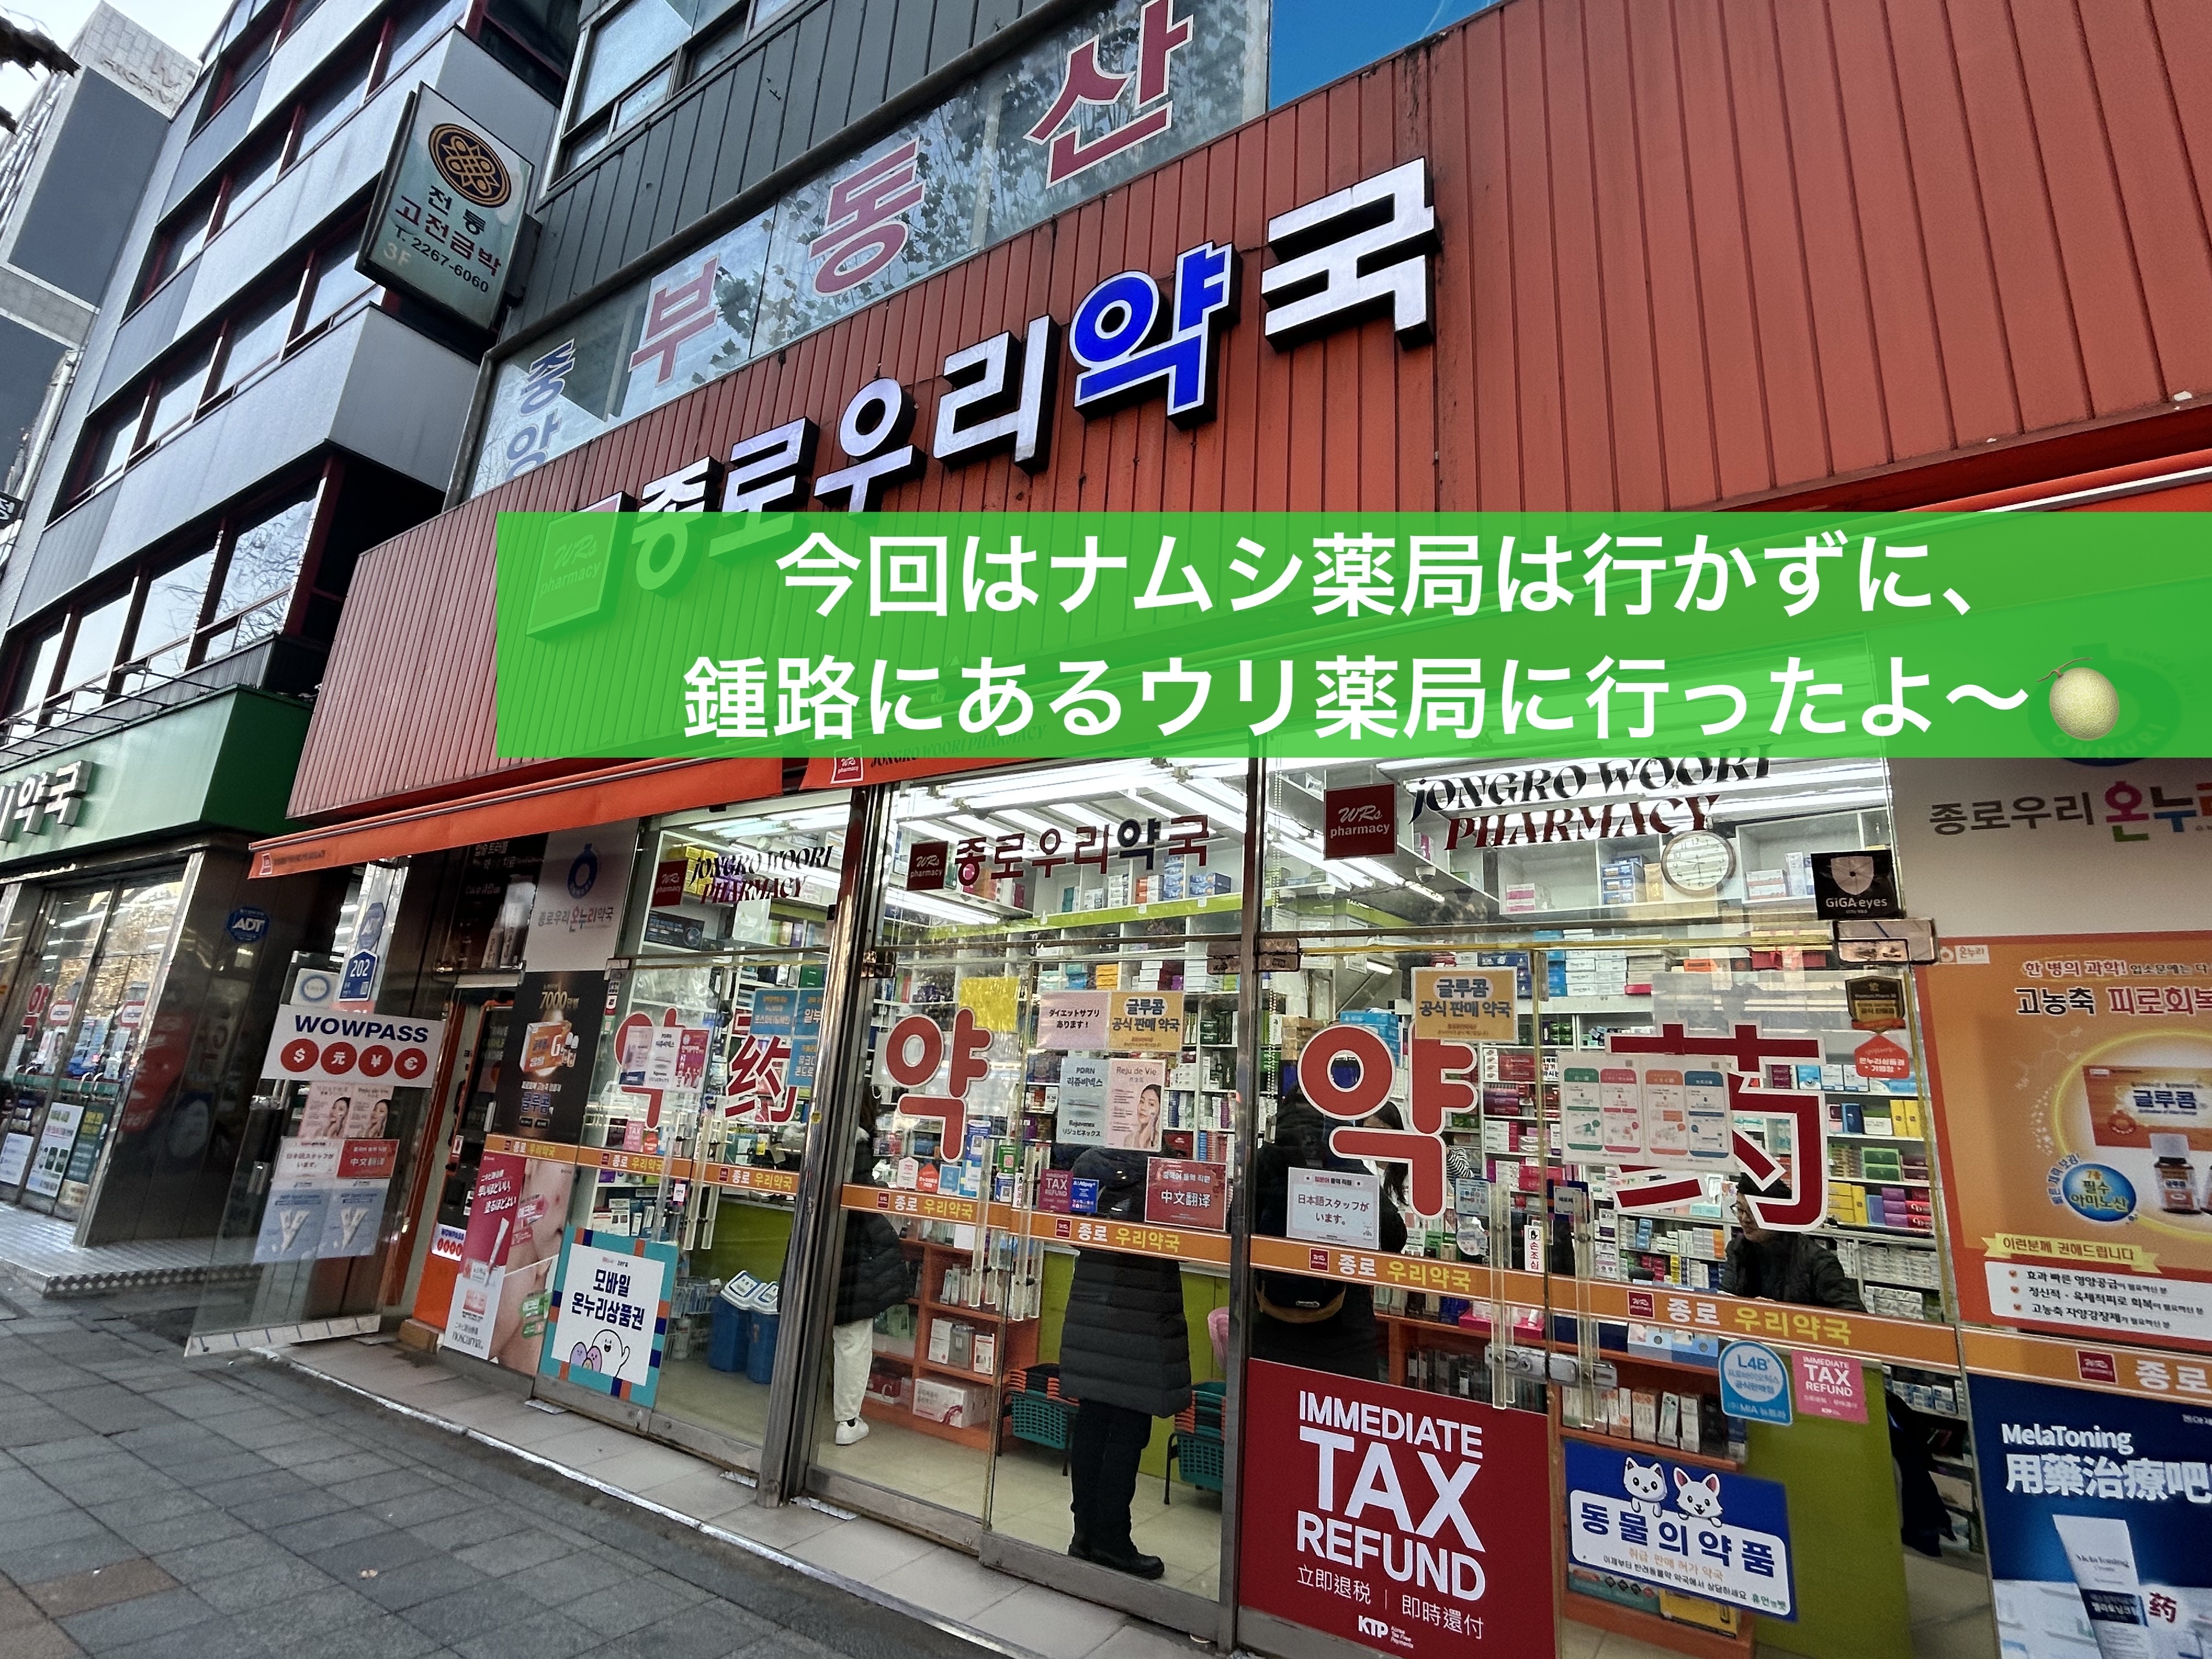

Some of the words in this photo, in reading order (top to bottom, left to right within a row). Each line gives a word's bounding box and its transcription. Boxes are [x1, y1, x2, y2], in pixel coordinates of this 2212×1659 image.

[384, 242, 412, 266] 3F
[411, 236, 489, 293] 2267-6060
[632, 156, 1436, 592] 종로우리약국
[539, 561, 602, 599] pharmacy
[1599, 743, 1773, 793] WOORI
[0, 760, 82, 840] 약국
[1338, 805, 1383, 823] WRs
[1330, 821, 1391, 839] pharmacy
[1444, 795, 1720, 850] PHARMACY
[916, 854, 940, 870] WRs
[955, 815, 1211, 887] 종로우리약국
[910, 865, 943, 879] pharmacy
[700, 876, 808, 905] PHARMACY
[1859, 898, 1888, 910] eyes
[232, 918, 265, 933] ADT
[350, 958, 370, 977] 202
[2025, 962, 2041, 976] 한
[2047, 961, 2080, 976] 병의
[2085, 961, 2126, 975] 과학!
[1436, 979, 1489, 998] 글루콤
[2016, 987, 2095, 1015] 고농축
[1048, 1008, 1100, 1018] ダイエットサプリ
[1125, 998, 1165, 1015] 글루콤
[1419, 1000, 1447, 1017] 공식
[1449, 1001, 1480, 1018] 판매
[1482, 1001, 1512, 1018] 약국
[295, 1014, 430, 1043] WOWPASS
[1111, 1017, 1132, 1032] 공식
[1134, 1017, 1156, 1032] 판매
[1158, 1018, 1181, 1032] 약국
[885, 1007, 994, 1163] 약
[2133, 1090, 2197, 1109] 글루콤
[1298, 1020, 1477, 1219] 약
[612, 1154, 628, 1167] 종로
[731, 1170, 751, 1185] 종로
[754, 1171, 793, 1191] 우리약국
[1046, 1177, 1068, 1190] TAX
[895, 1195, 918, 1212] 종로
[924, 1199, 974, 1220] 우리약국
[1161, 1189, 1211, 1208] 中文翻译
[1297, 1193, 1370, 1212] 日本語スタッフが
[1314, 1211, 1346, 1226] います。
[1077, 1222, 1108, 1243] 종로
[1115, 1228, 1181, 1254] 우리약국
[1530, 1241, 1539, 1270] 손조심
[592, 1268, 631, 1298] 모바일
[1338, 1254, 1377, 1277] 종로
[1387, 1260, 1471, 1291] 우리약국
[572, 1291, 645, 1331] 온누리상품권
[1667, 1297, 1720, 1326] 종로
[1735, 1307, 1852, 1346] 우리약국
[1803, 1355, 1850, 1370] IMMEDIATE
[1803, 1363, 1852, 1387] TAX
[1805, 1381, 1853, 1397] REFUND
[2136, 1359, 2212, 1395] 종로
[1299, 1390, 1483, 1460] IMMEDIATE
[2001, 1423, 2135, 1456] MelaToning
[1299, 1425, 1486, 1553] TAX
[1581, 1502, 1775, 1578] 동물의약품
[1296, 1510, 1486, 1602] REFUND
[1628, 1547, 1649, 1563] 취급
[1654, 1553, 1674, 1568] 판매
[1678, 1560, 1699, 1575] 허가
[1702, 1565, 1724, 1583] 약국
[1297, 1564, 1372, 1605] 立即退税
[1401, 1593, 1484, 1640] 即時還付
[2148, 1591, 2177, 1624] 药
[1358, 1615, 1389, 1639] KTP
